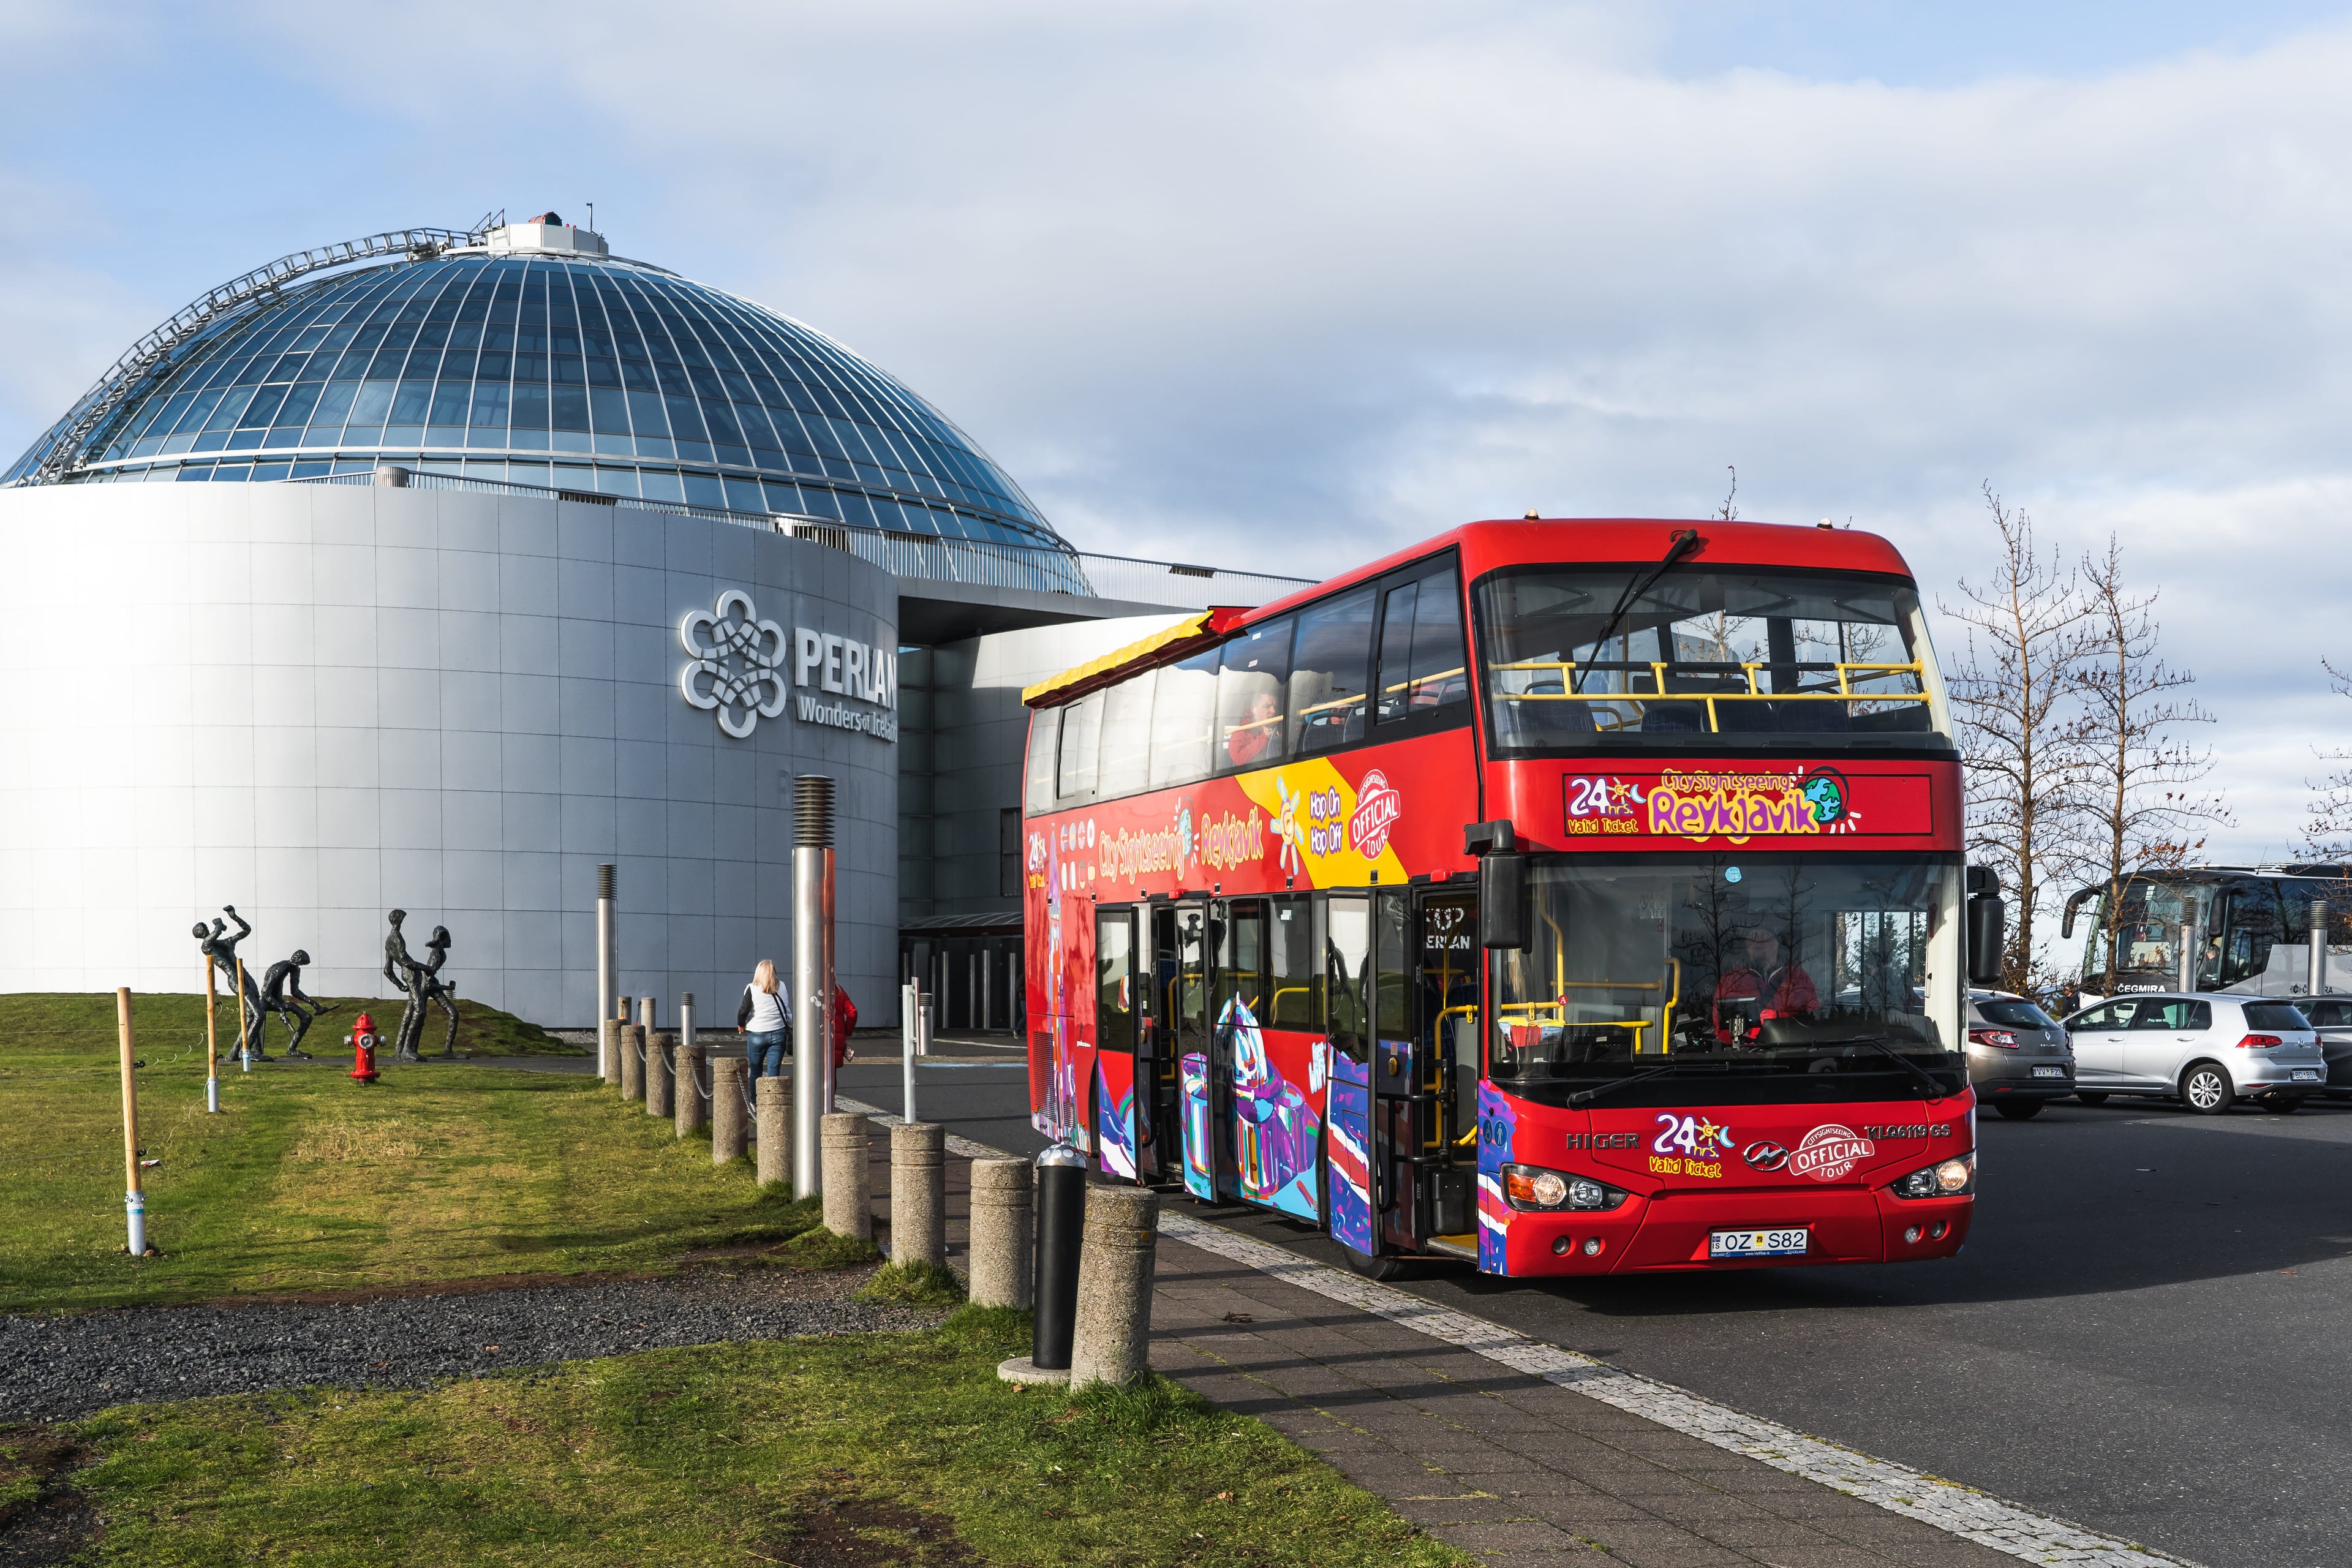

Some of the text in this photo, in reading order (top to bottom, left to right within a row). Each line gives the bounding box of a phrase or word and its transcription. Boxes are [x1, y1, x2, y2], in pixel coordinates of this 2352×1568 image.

[796, 627, 897, 711] PERLAN
[796, 696, 898, 744] Wonders of Iceland
[1310, 785, 1341, 823] Hop On
[1569, 777, 1610, 816] 24
[1352, 794, 1398, 843] OFFICIAL
[1568, 818, 1639, 834] Valid Ticket
[1648, 786, 1820, 845] Reykjavik
[1201, 805, 1264, 872] Reykjavik
[1310, 821, 1343, 859] Hop Off
[1366, 829, 1387, 856] TOUR
[2117, 983, 2166, 993] ČEGMIRA
[1566, 1133, 1640, 1149] HIGER
[1653, 1114, 1697, 1155] 24
[1807, 1128, 1851, 1145] CITYSIGHTSEEING
[1868, 1125, 1951, 1140] KLQ6119 GS
[1649, 1156, 1722, 1178] Valid Ticket
[1797, 1141, 1870, 1170] OFFICIAL
[1820, 1161, 1852, 1178] TOUR
[1725, 1234, 1752, 1250] OZ
[1768, 1232, 1804, 1248] S82
